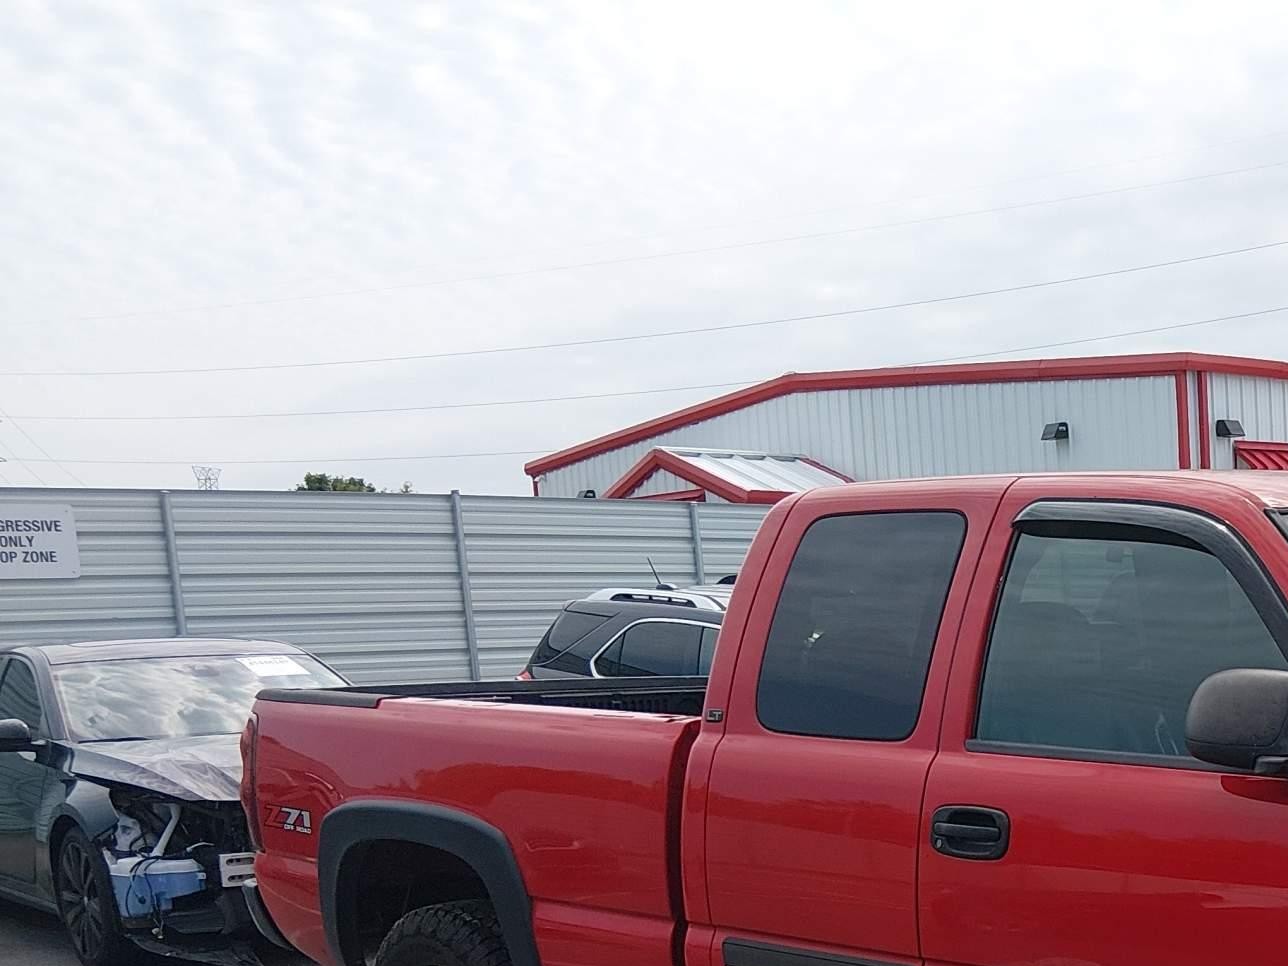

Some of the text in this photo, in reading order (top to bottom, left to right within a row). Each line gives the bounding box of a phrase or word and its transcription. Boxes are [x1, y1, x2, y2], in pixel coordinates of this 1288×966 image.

[0, 535, 34, 548] ONLY
[0, 551, 58, 563] OP ZONE
[707, 711, 722, 720] LT
[264, 803, 312, 829] Z71
